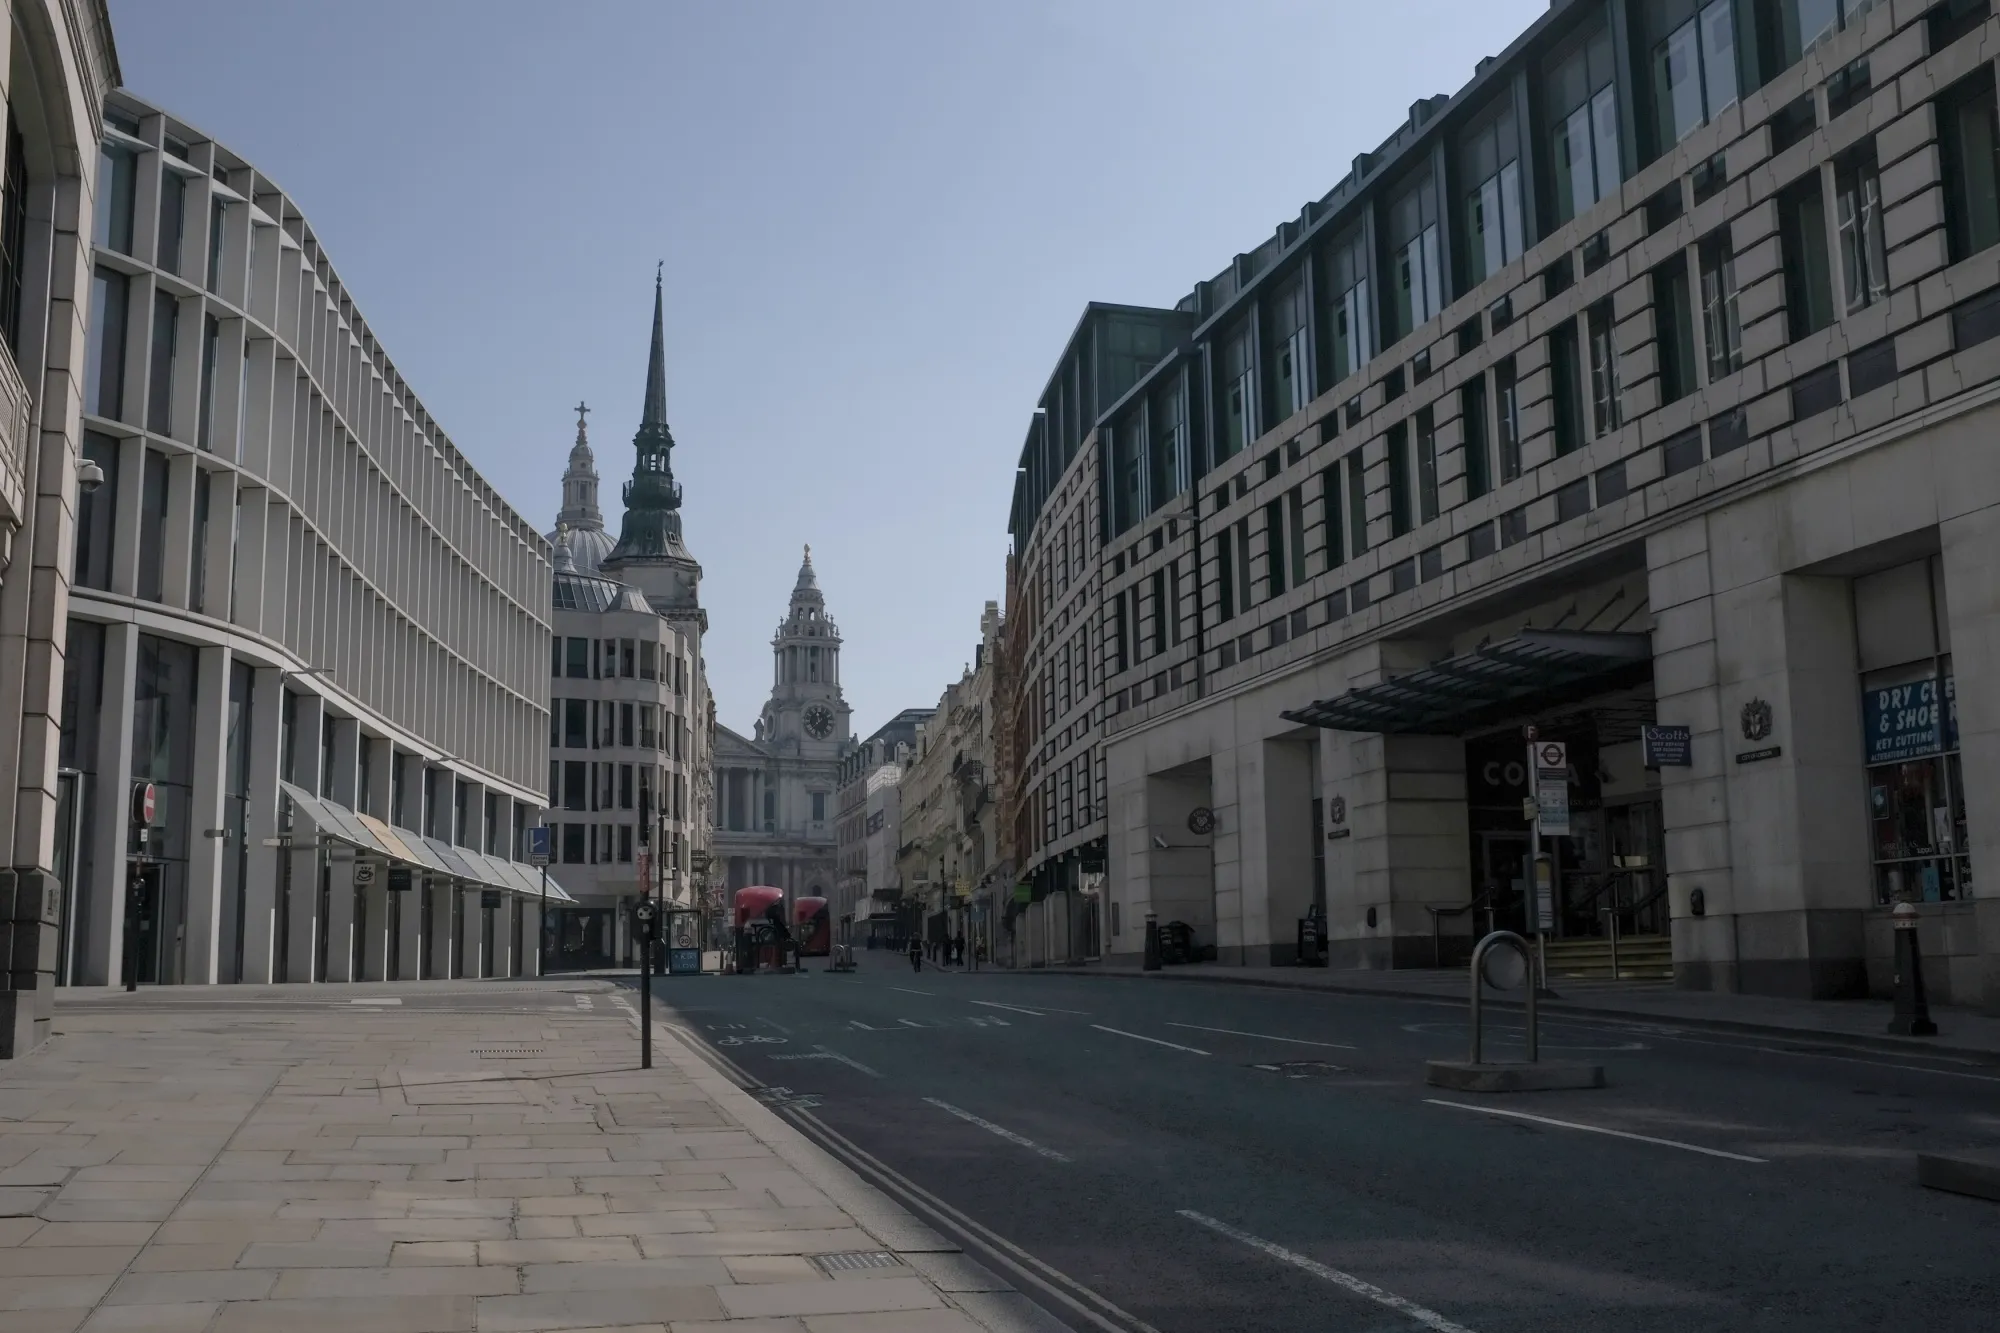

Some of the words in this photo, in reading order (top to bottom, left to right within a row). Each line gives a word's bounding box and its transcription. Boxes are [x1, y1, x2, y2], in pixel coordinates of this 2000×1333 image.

[1879, 685, 1912, 711] DRY
[1880, 713, 1890, 733] &
[1896, 703, 1939, 731] SHOE
[1527, 725, 1537, 739] F
[1646, 727, 1689, 740] Scotts
[1876, 737, 1892, 751] KEY
[1895, 730, 1934, 747] CUTTING
[1483, 761, 1580, 787] COA
